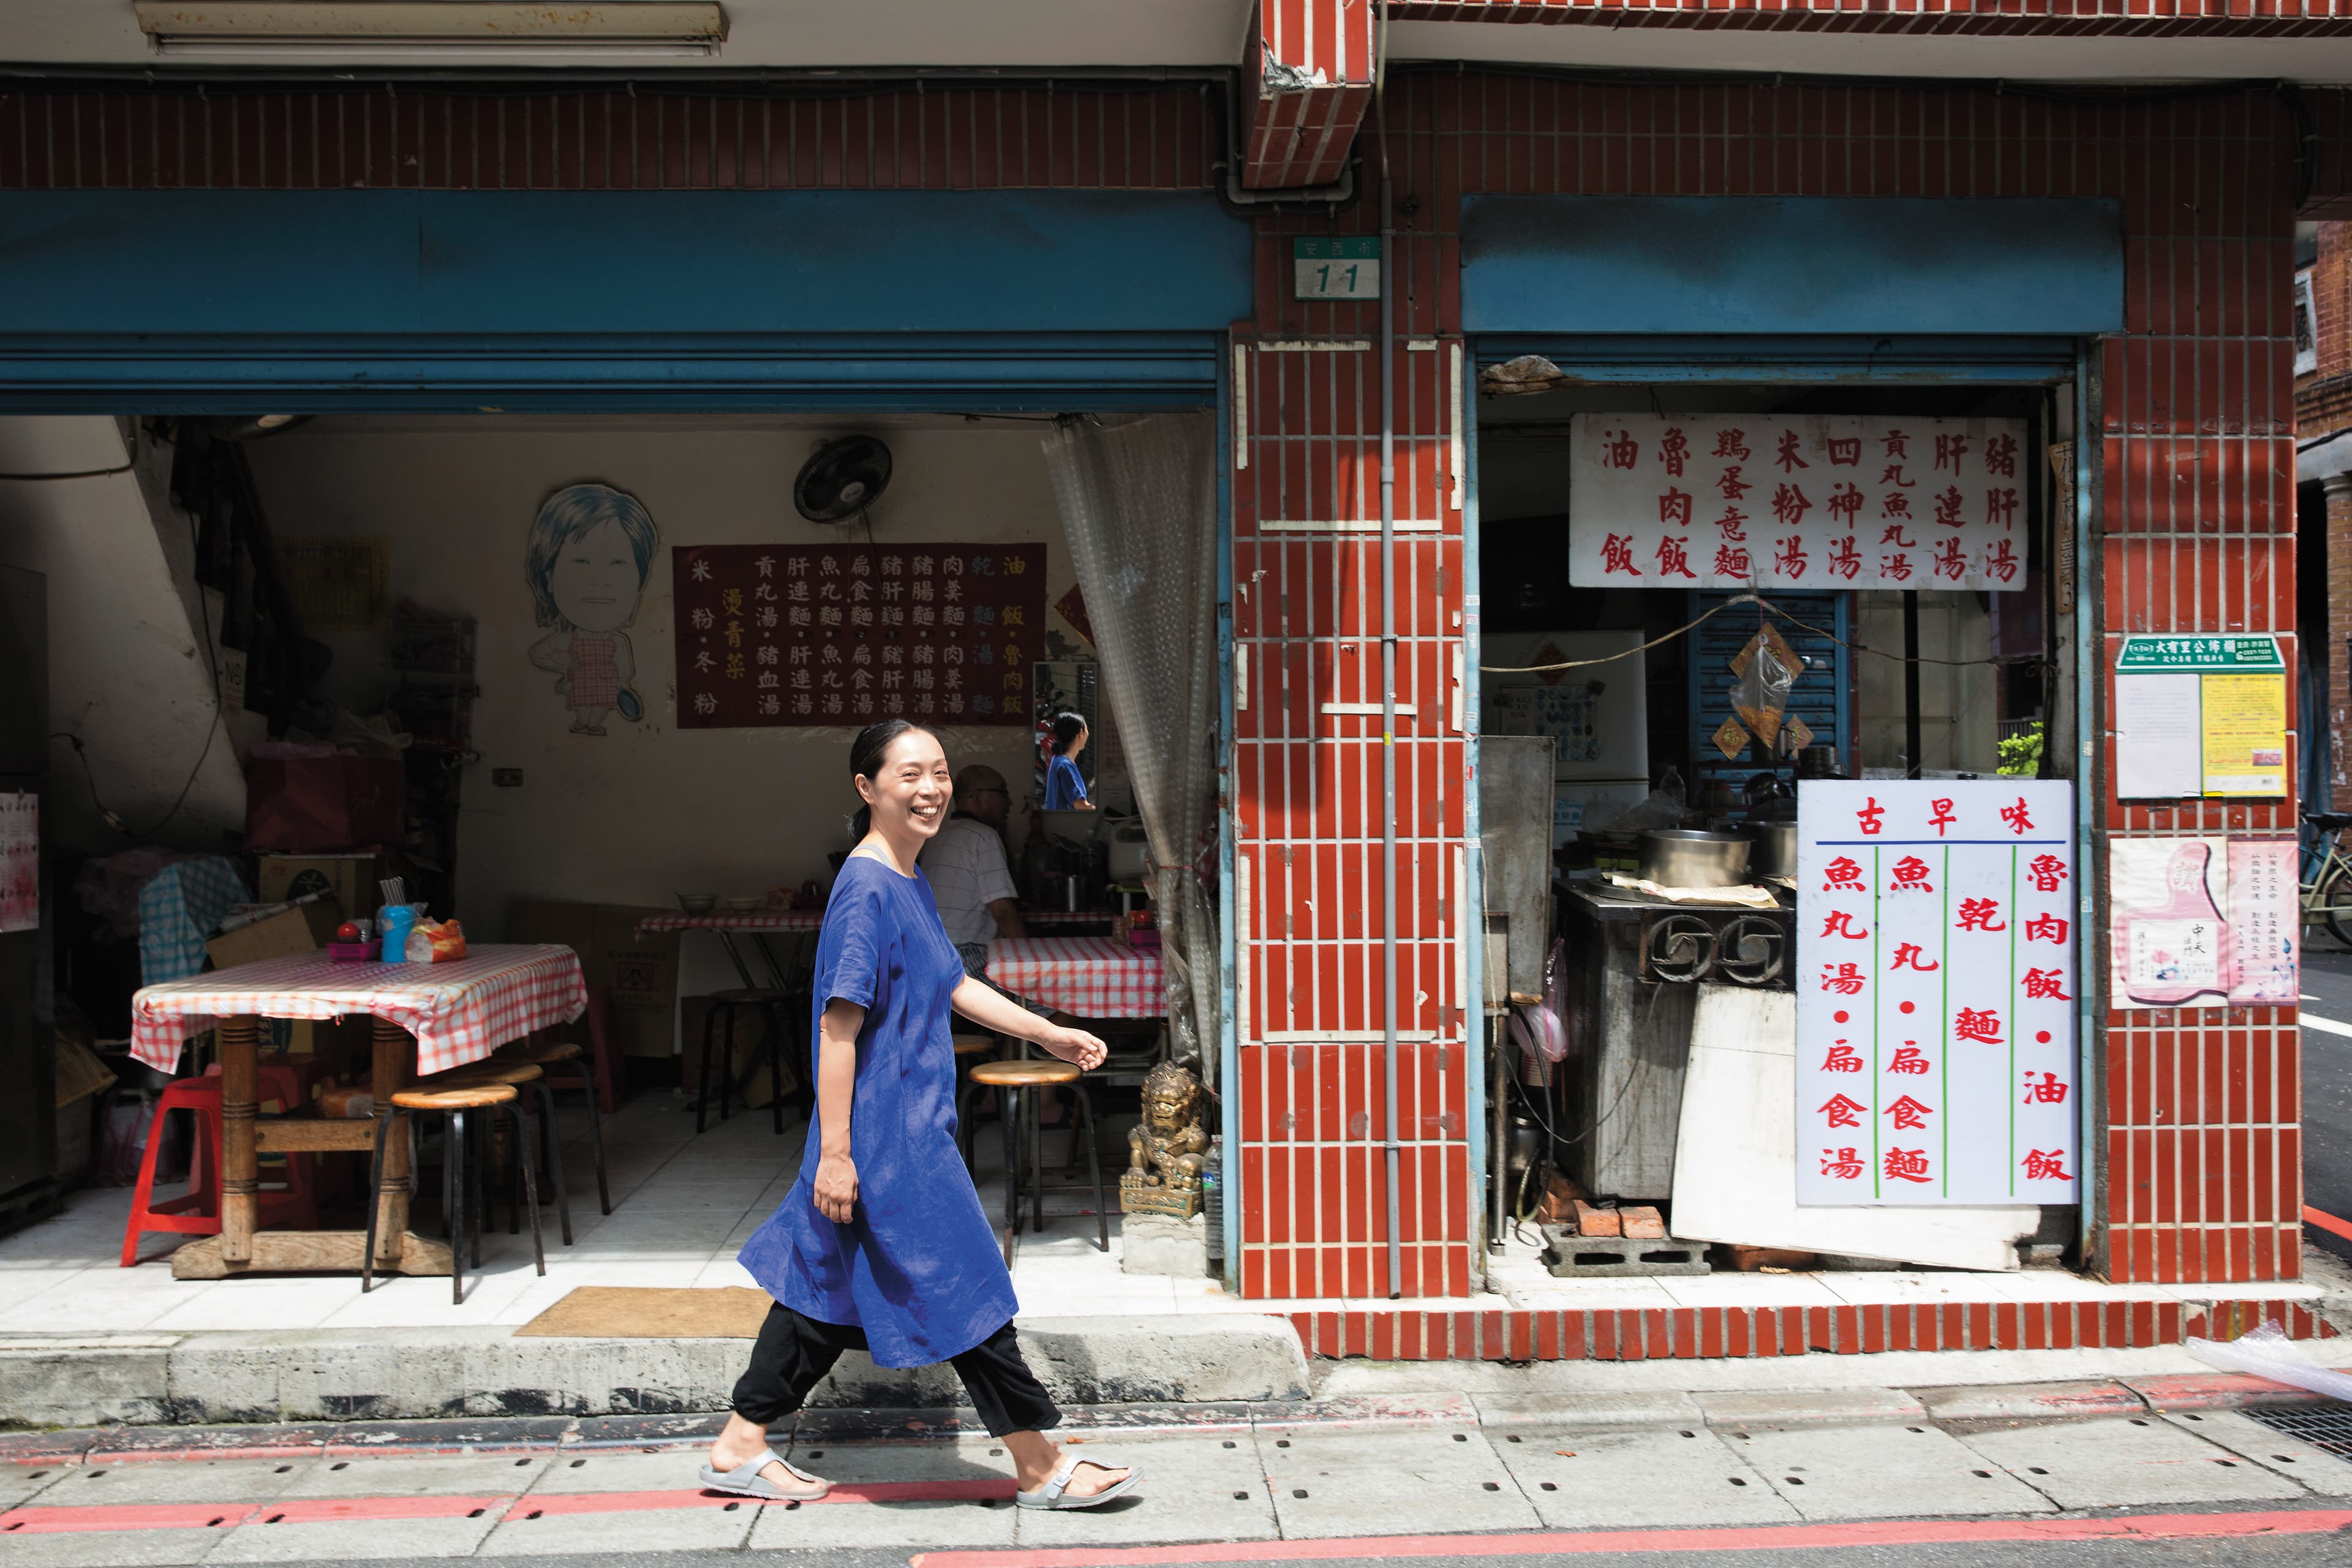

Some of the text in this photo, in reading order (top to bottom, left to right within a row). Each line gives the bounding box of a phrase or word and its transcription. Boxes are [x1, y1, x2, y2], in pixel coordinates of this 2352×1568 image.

[1317, 264, 1358, 292] 11
[1600, 429, 1643, 577] 油飯
[1655, 427, 1697, 579] 魯肉飯
[1771, 428, 1812, 581] 米粉湯
[1827, 431, 1865, 581] 四神湯
[1879, 429, 1917, 582] 貢丸魚丸湯
[1934, 432, 1968, 582] 肝連湯
[1985, 432, 2020, 583] 豬肝湯
[722, 588, 745, 680] 燙青菜
[1856, 797, 2035, 837] 古早味
[1955, 897, 2007, 1046] 乾麵
